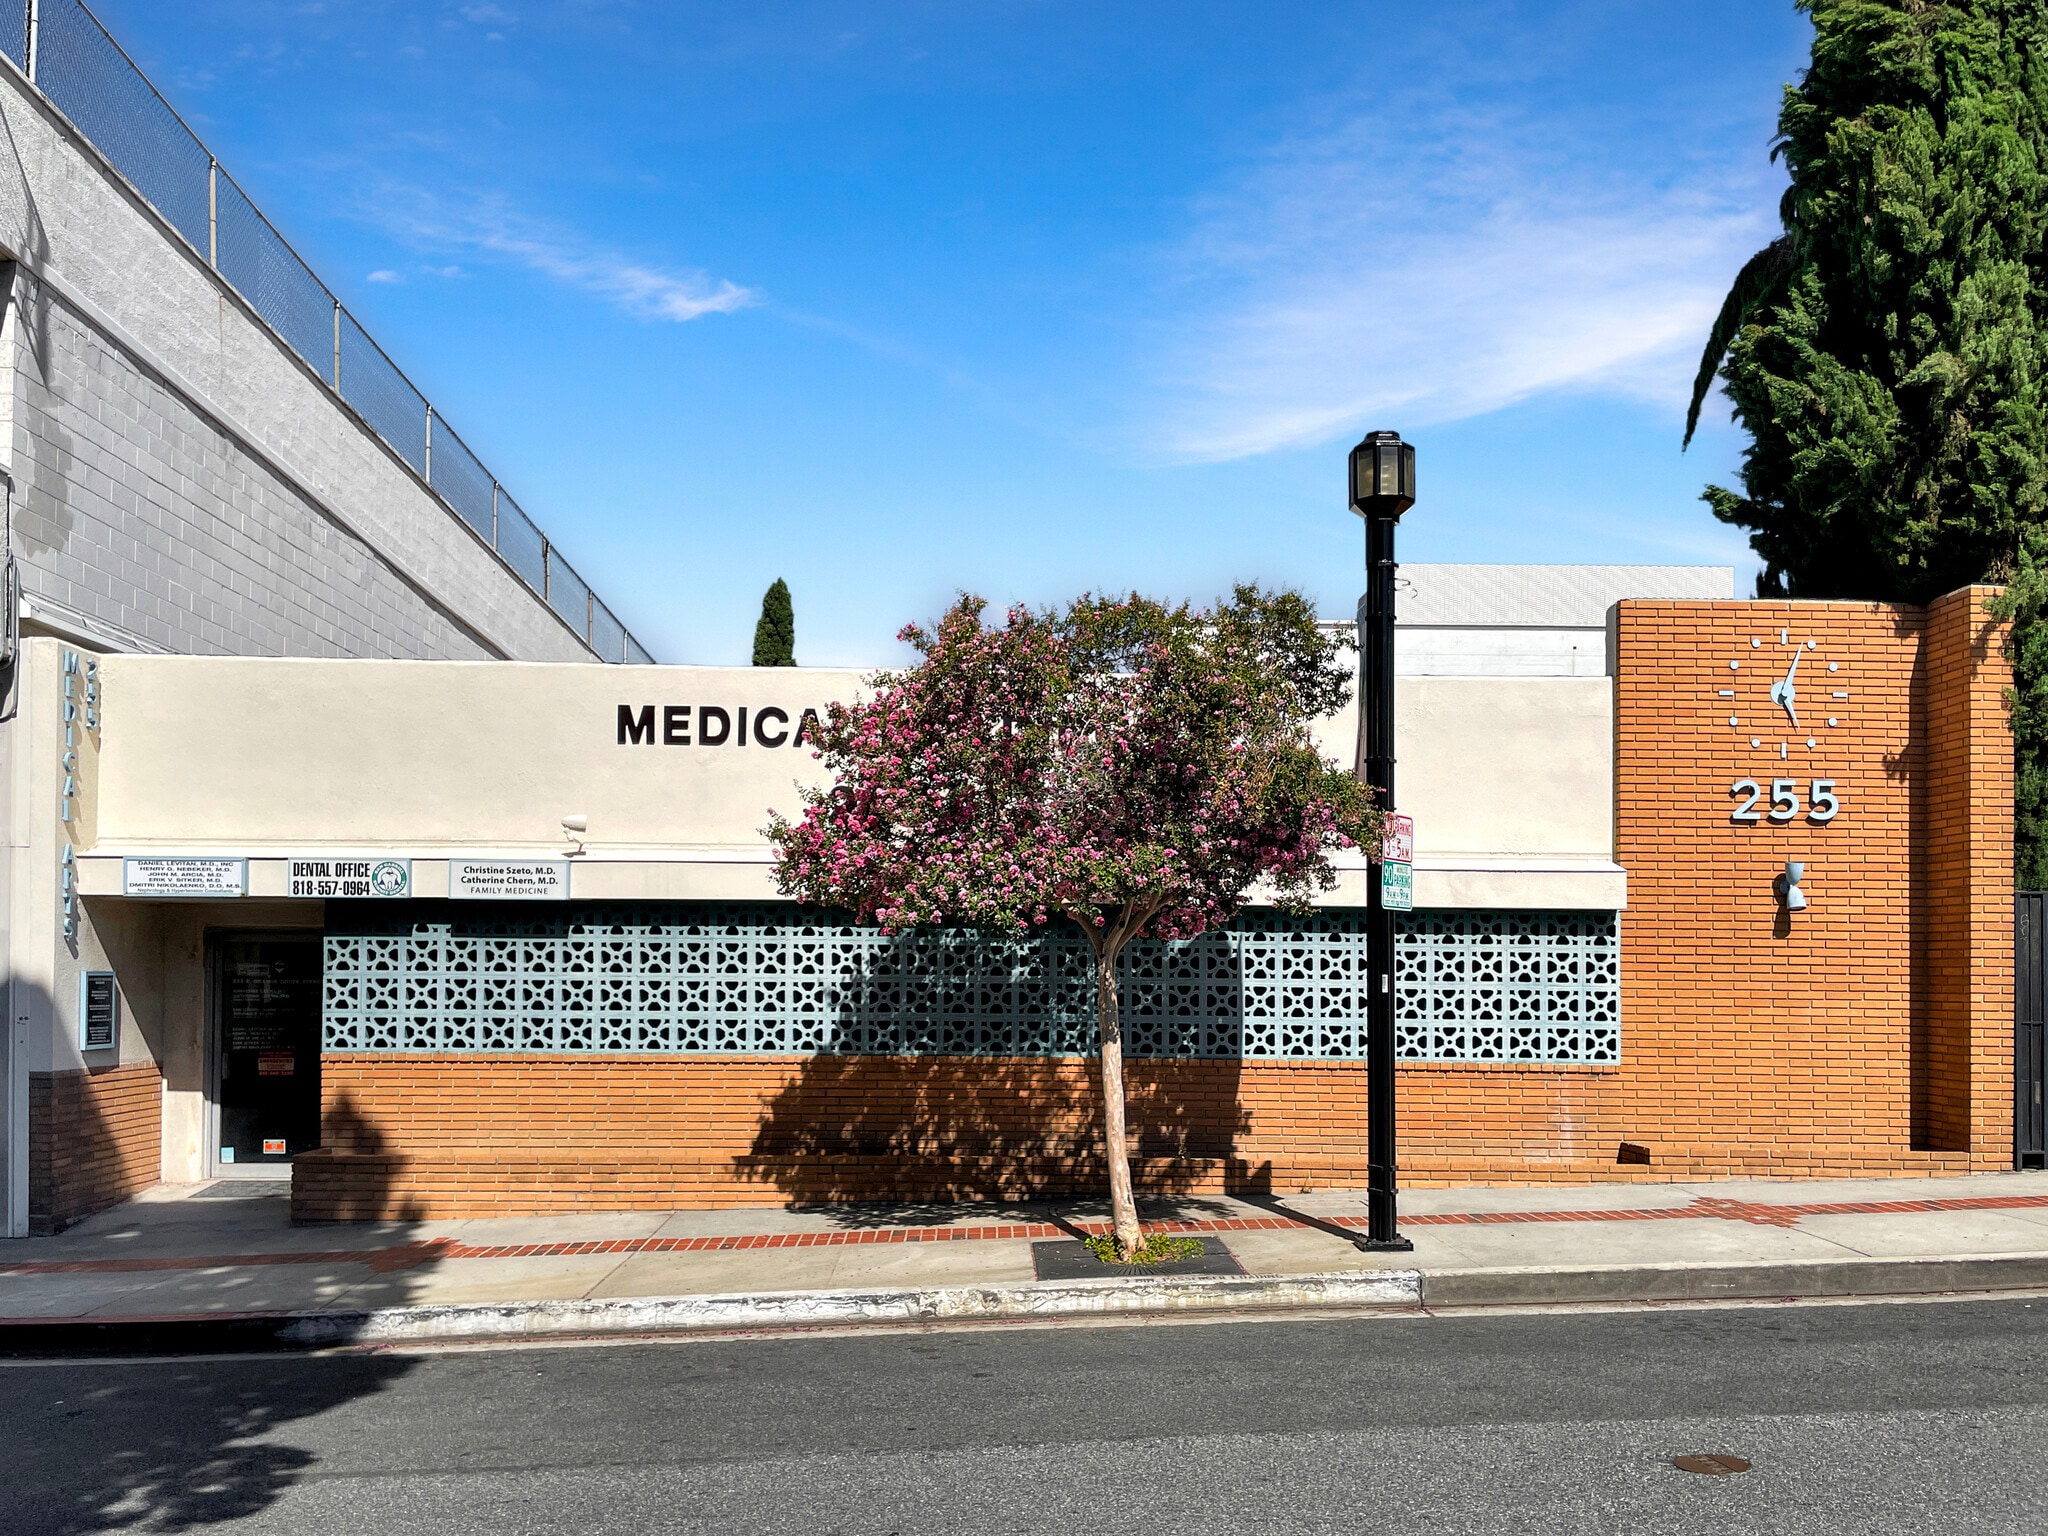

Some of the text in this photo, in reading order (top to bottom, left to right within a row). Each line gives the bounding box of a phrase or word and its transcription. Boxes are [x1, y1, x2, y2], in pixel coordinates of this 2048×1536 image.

[617, 704, 832, 748] MEDICA
[62, 650, 79, 939] MEDICAL ARTS
[1731, 779, 1840, 821] 255
[293, 862, 370, 878] DENTAL OFFICE
[463, 866, 556, 876] Christine Szeto, M.D.
[1384, 864, 1393, 885] 90
[293, 880, 370, 896] 818-557-0964
[461, 876, 558, 885] Catherine Chern, M.D.
[505, 887, 548, 895] MEDICINE
